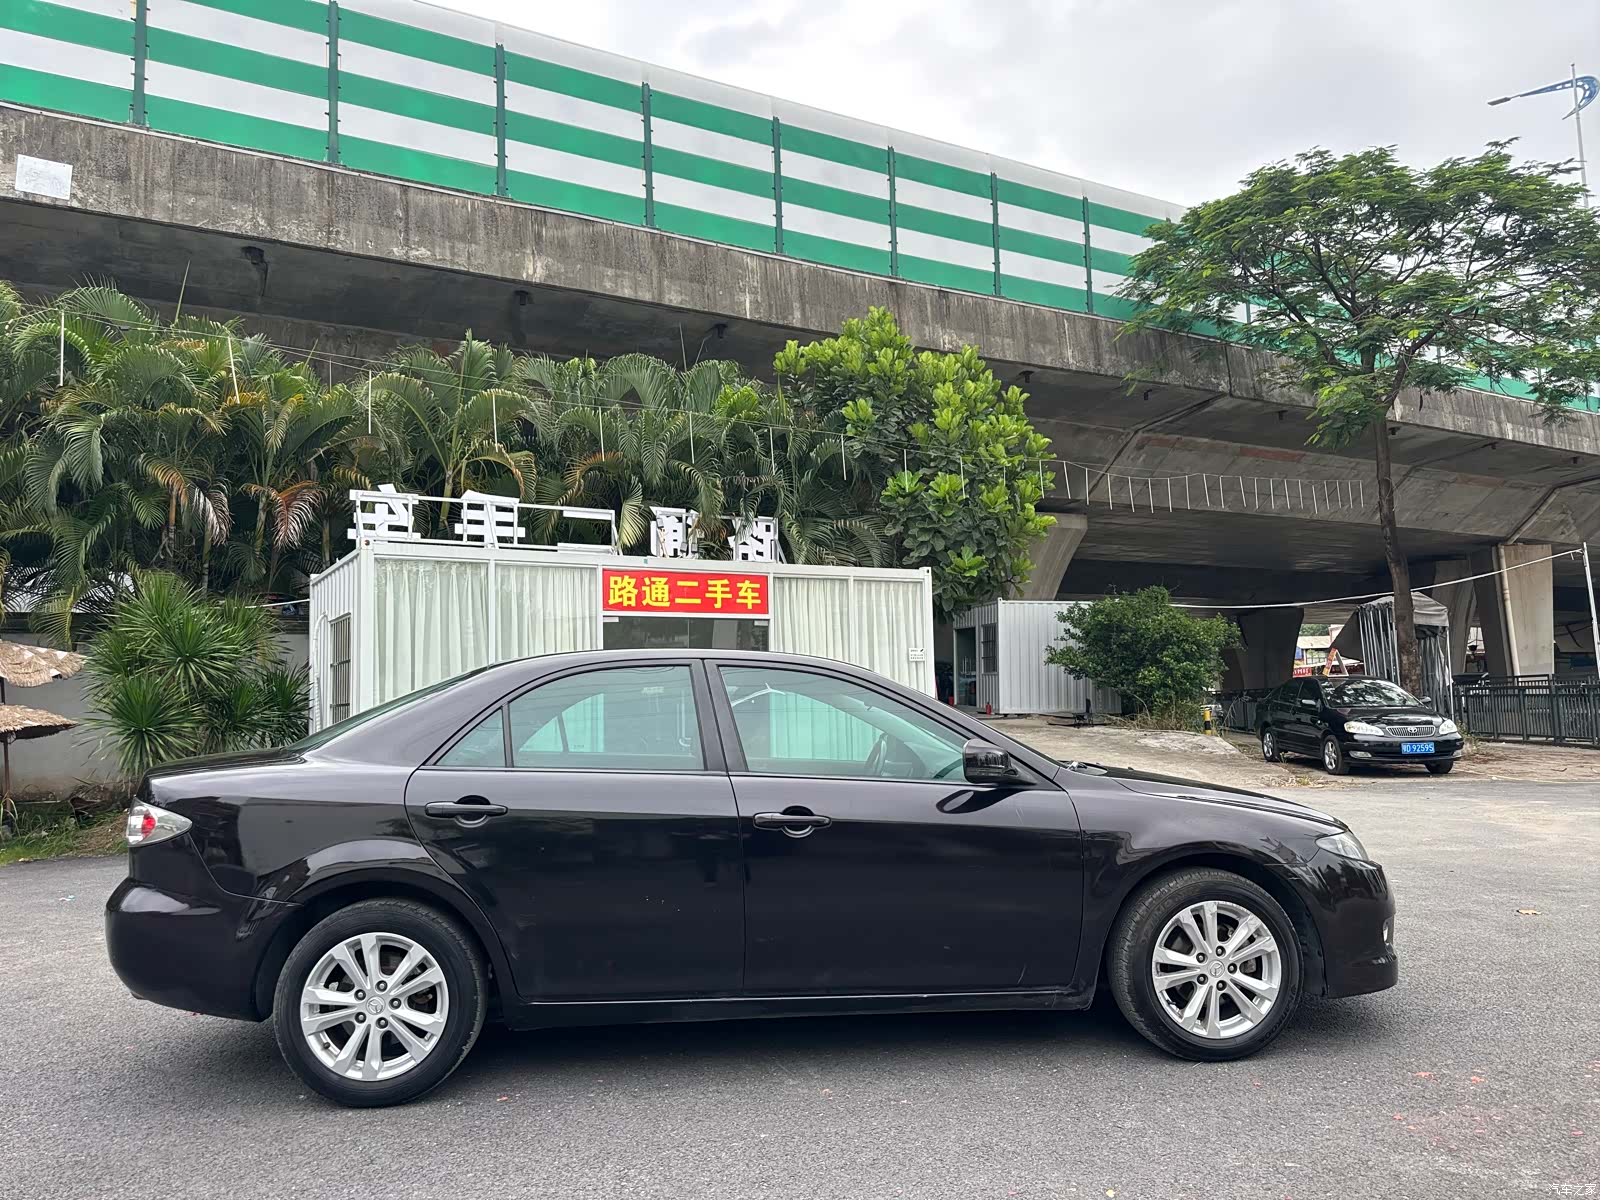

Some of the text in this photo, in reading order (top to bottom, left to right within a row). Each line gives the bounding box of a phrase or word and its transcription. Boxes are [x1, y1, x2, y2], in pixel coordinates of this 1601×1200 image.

[608, 575, 762, 609] 路通二手车
